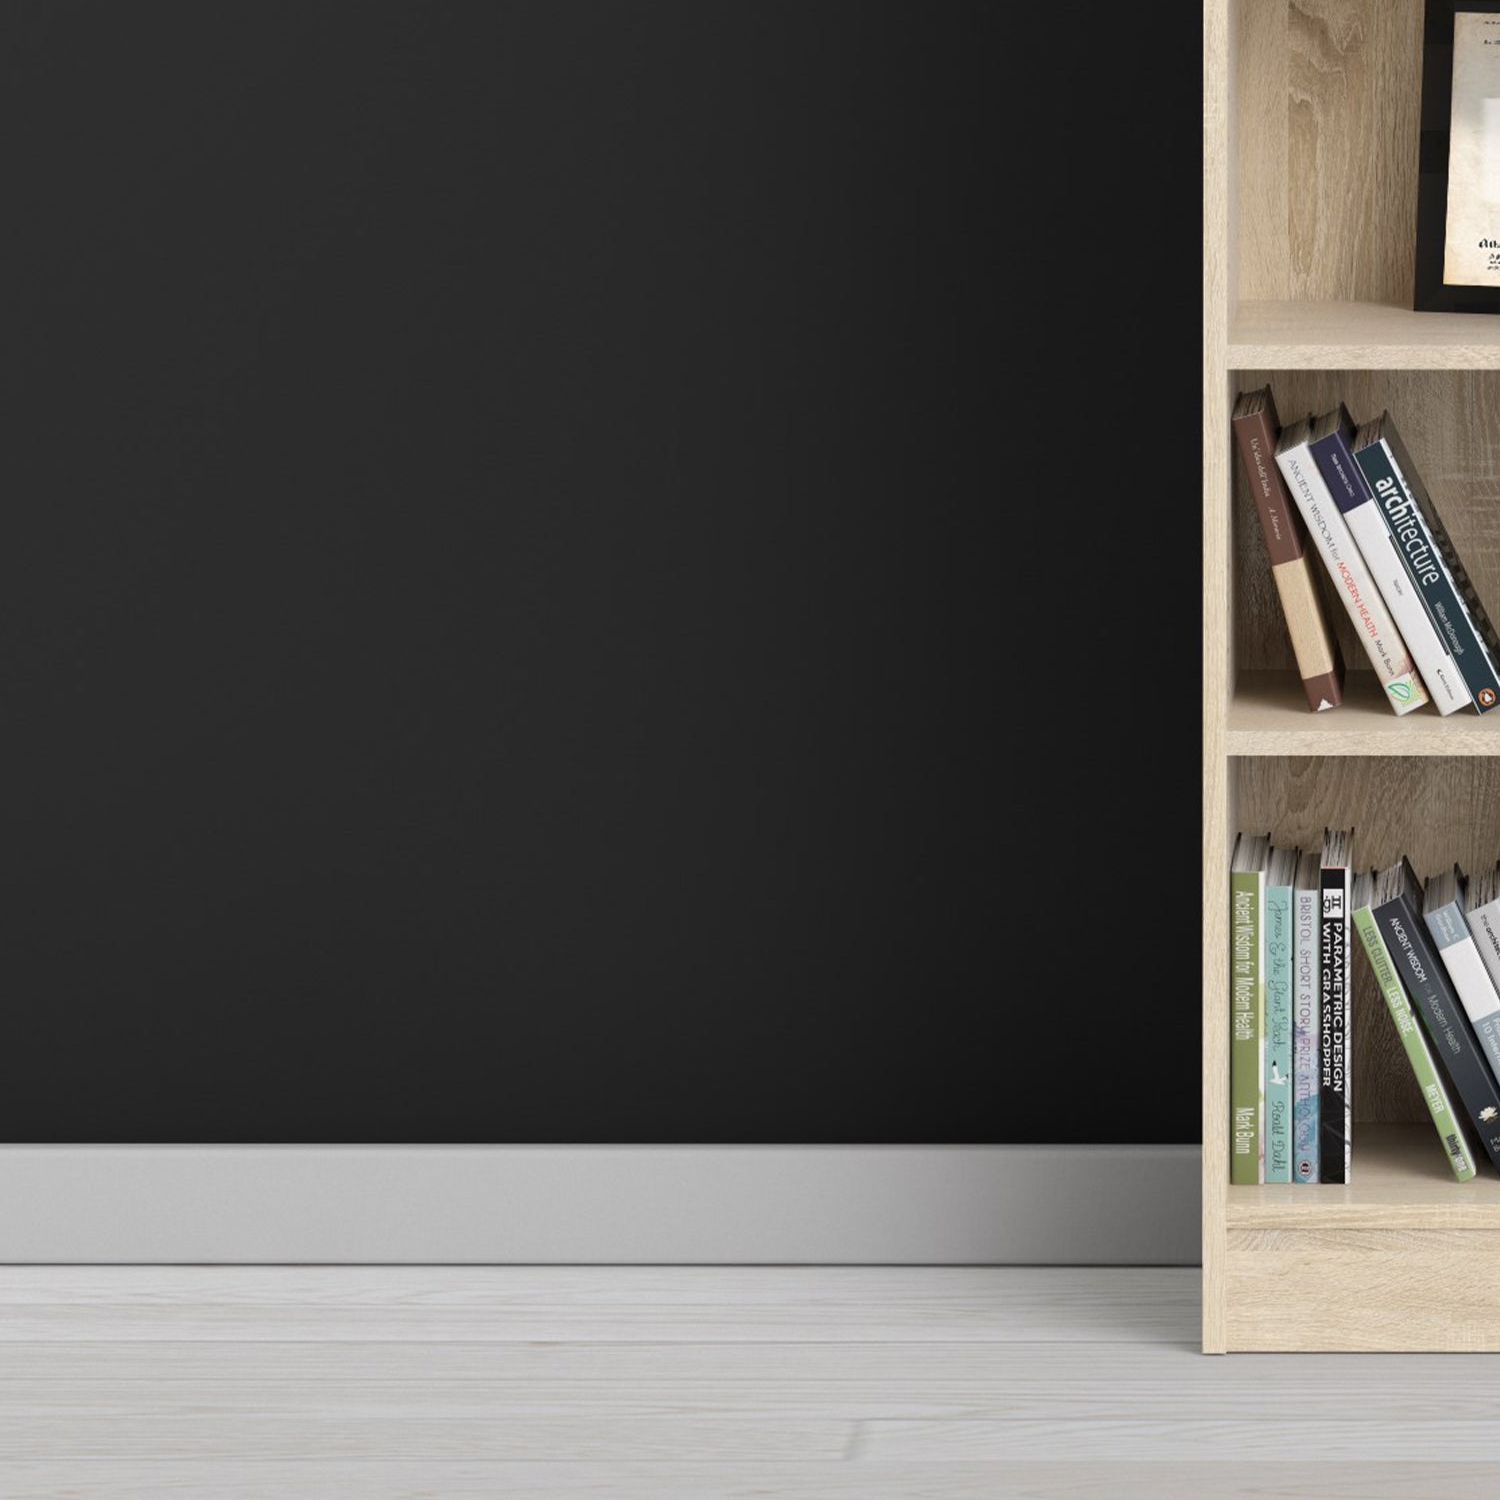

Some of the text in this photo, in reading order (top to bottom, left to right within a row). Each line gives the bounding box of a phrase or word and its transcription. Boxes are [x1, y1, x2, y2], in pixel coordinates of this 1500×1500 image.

[1287, 457, 1314, 504] ANCIENT
[1308, 503, 1335, 549] WISDOM
[1336, 560, 1362, 603] MODERN
[1356, 603, 1379, 638] HEALTH
[1375, 475, 1440, 586] architecture
[1433, 600, 1449, 623] William
[1373, 638, 1387, 657] Mark
[1268, 901, 1287, 938] James
[1299, 896, 1311, 945] BRISTOL
[1480, 914, 1489, 926] the
[1322, 922, 1330, 963] WITH
[1235, 891, 1254, 1039] Ancient Wisdom for Modern Health
[1272, 958, 1285, 975] the
[1299, 949, 1311, 989] SHORT
[1362, 925, 1379, 947] LESS
[1385, 985, 1403, 1008] LESS
[1394, 1008, 1414, 1036] NOISE.
[1389, 916, 1412, 951] ANCIENT
[1405, 948, 1427, 982] WISDOM
[1427, 993, 1449, 1027] Modern
[1443, 1026, 1463, 1054] Health
[1268, 980, 1287, 1013] Giant
[1333, 922, 1342, 1091] PARAMETRIC DESIGN
[1299, 1038, 1310, 1069] PRIZE
[1424, 1083, 1445, 1113] MEYER
[1235, 1107, 1253, 1153] Mark Bunn
[1271, 1100, 1284, 1172] Roald Dahl
